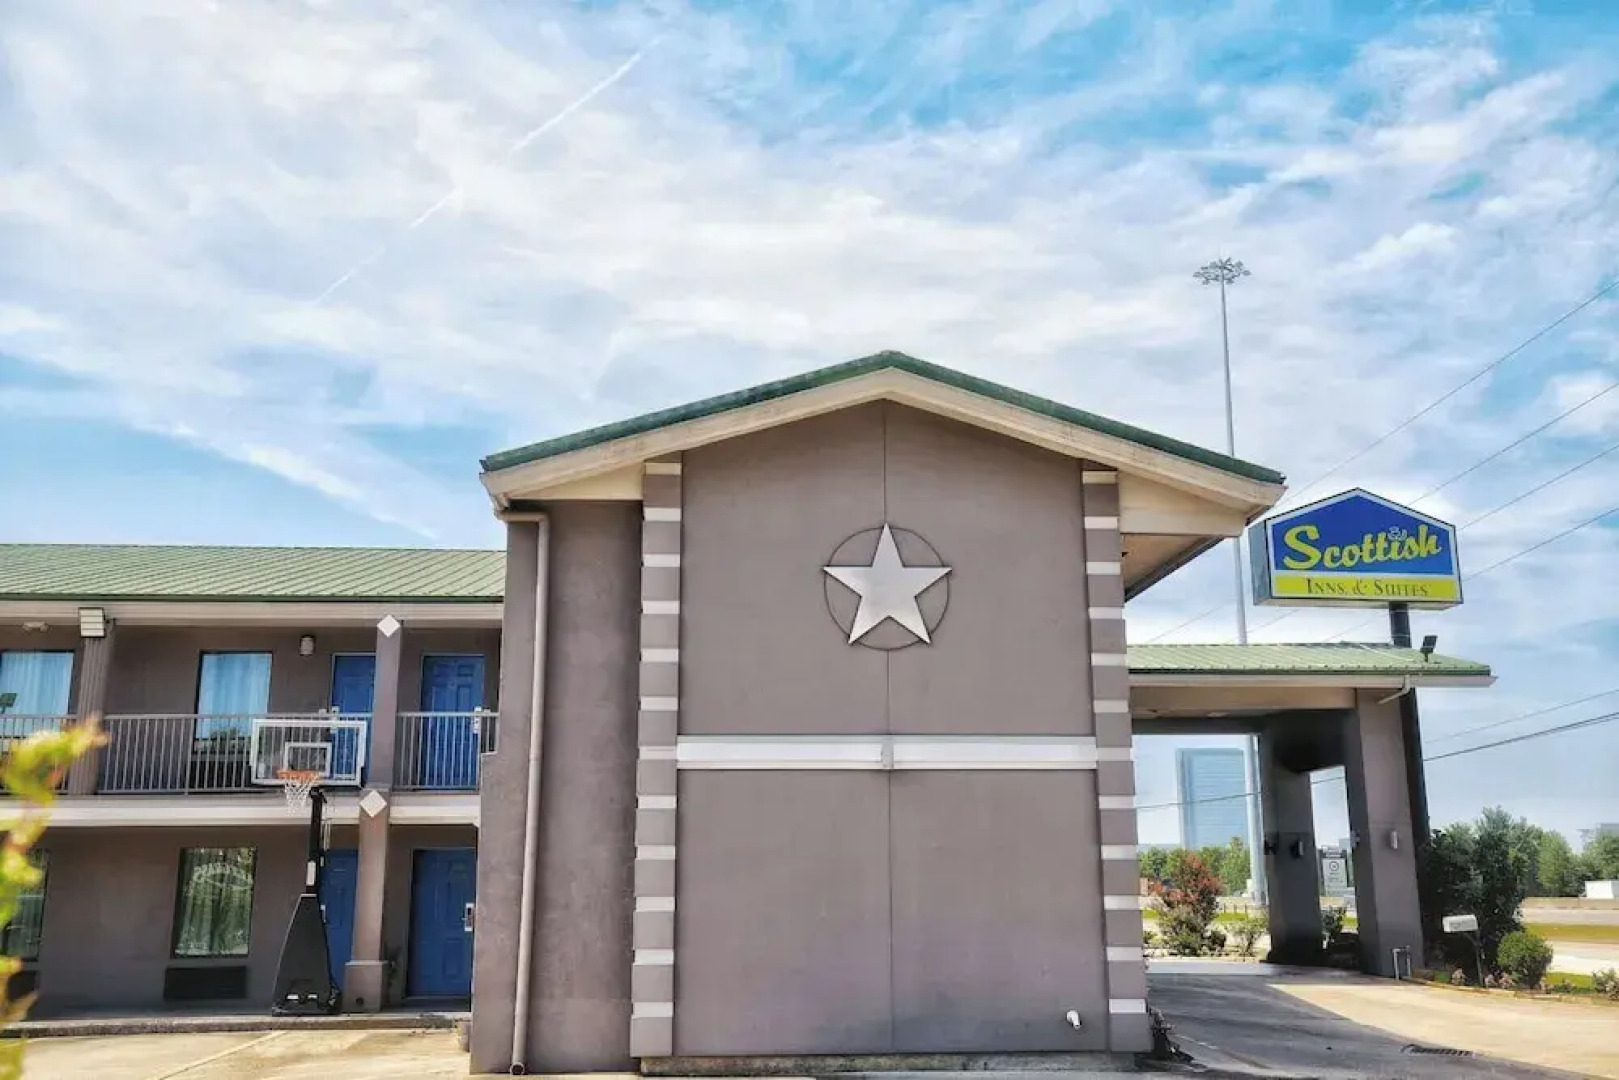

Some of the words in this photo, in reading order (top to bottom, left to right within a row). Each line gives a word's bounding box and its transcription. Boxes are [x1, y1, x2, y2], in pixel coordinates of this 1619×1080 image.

[1283, 524, 1441, 570] Scottish
[1352, 578, 1368, 595] &
[1373, 579, 1429, 597] SUITES
